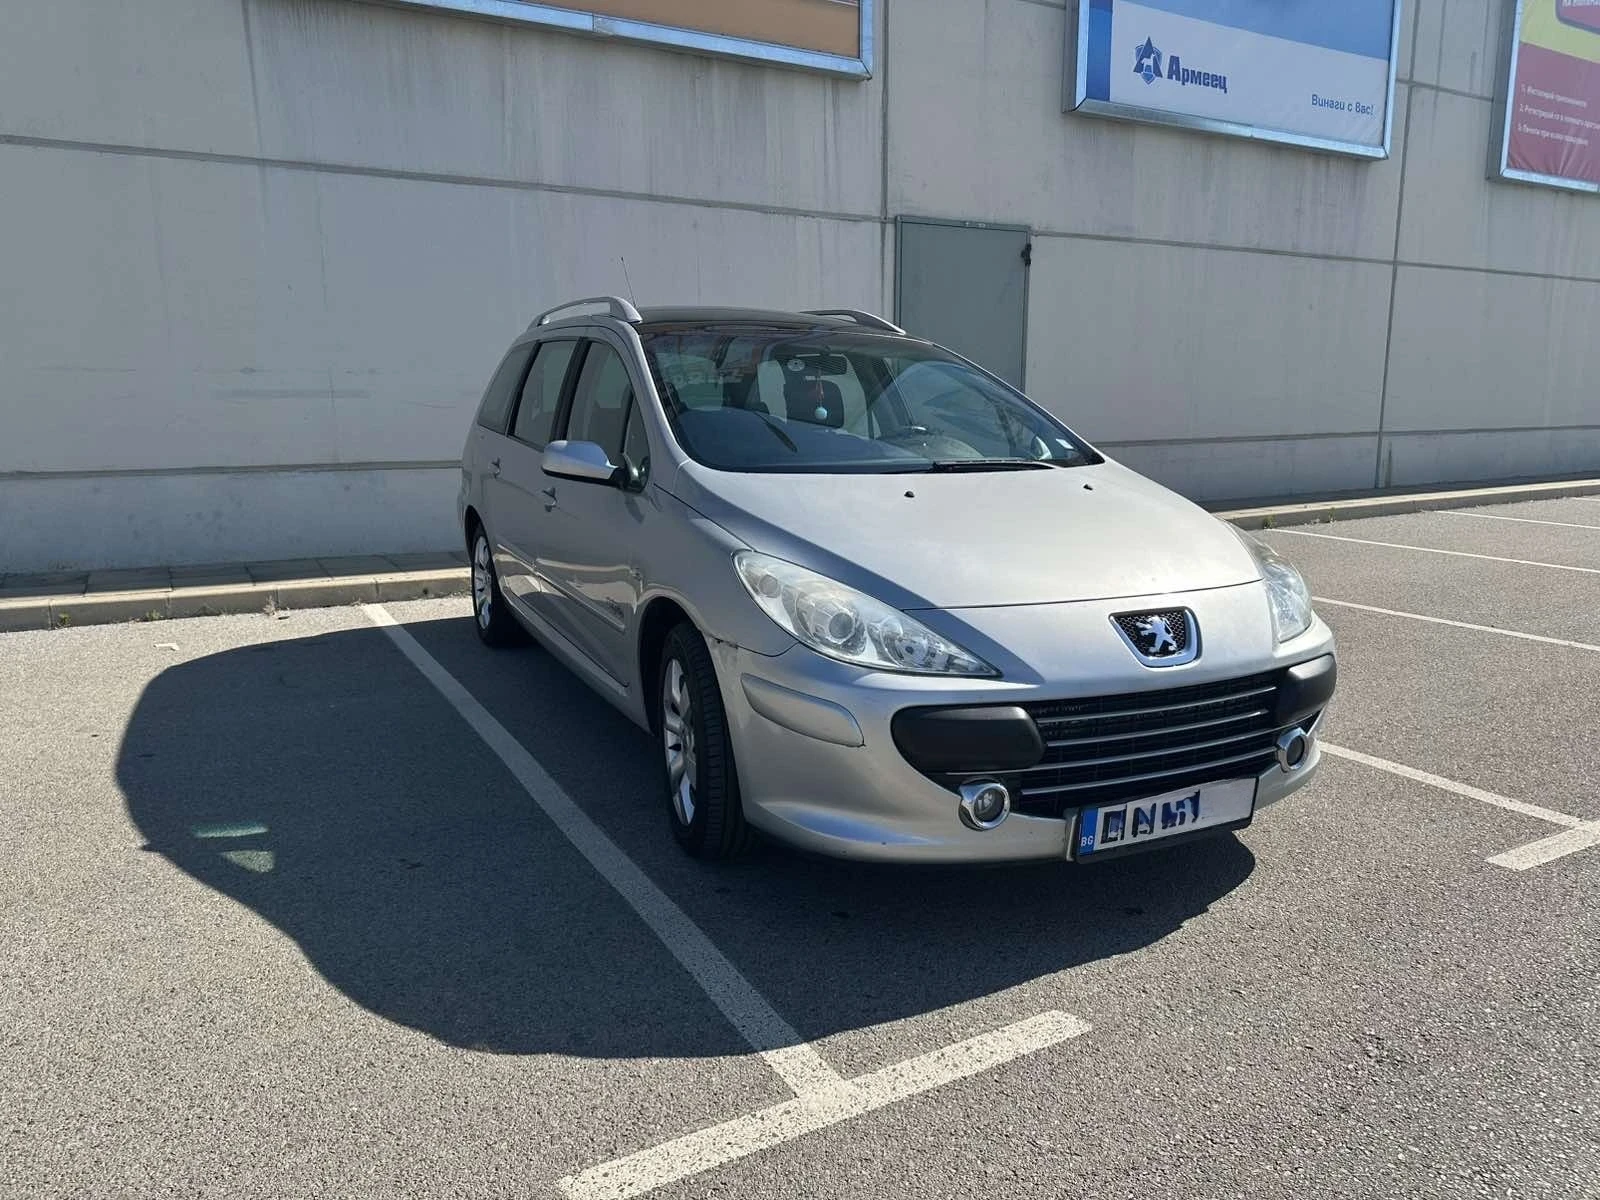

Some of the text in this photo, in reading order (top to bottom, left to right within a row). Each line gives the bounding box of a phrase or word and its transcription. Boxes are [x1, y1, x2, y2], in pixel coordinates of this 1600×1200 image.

[1167, 55, 1228, 94] Армеец
[1311, 94, 1345, 111] Винаги
[1355, 102, 1374, 115] Вас!
[1081, 835, 1094, 847] BG
